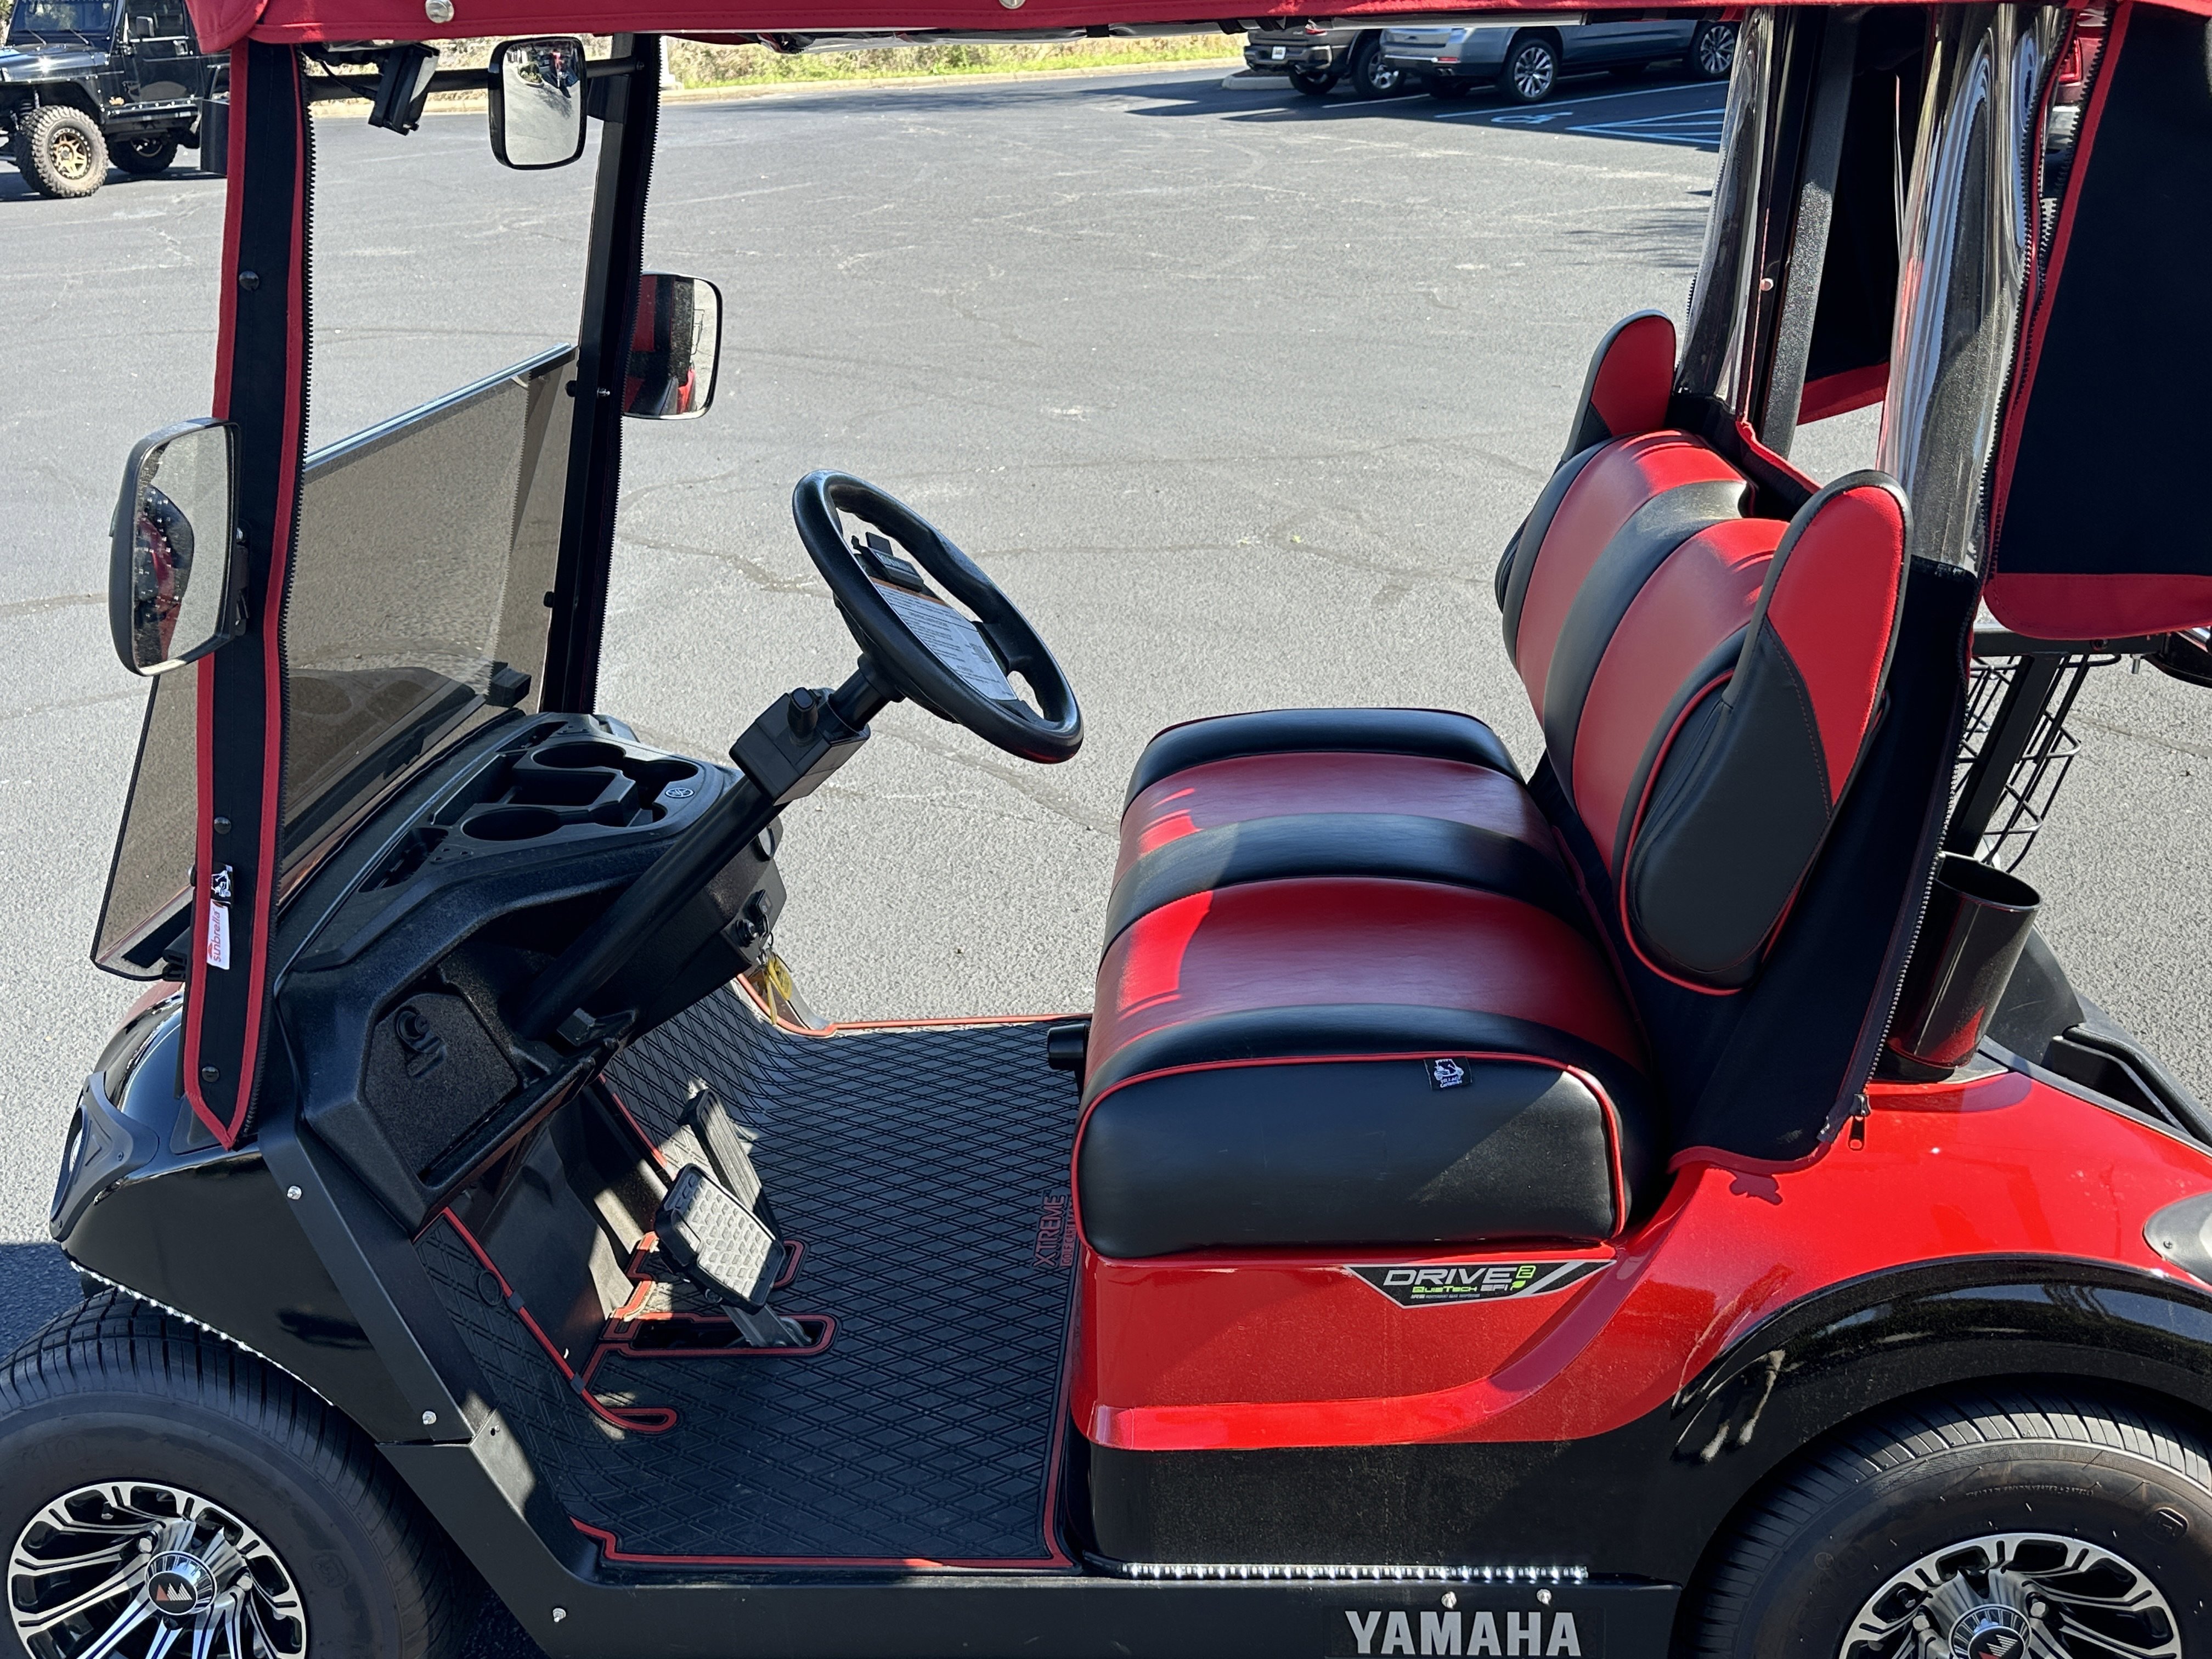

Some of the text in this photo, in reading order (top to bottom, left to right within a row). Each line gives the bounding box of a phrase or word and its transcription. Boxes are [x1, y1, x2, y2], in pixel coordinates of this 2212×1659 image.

[211, 911, 222, 962] sunbrella
[1032, 1194, 1065, 1267] XTREME
[1345, 1611, 1581, 1656] YAMAHA
